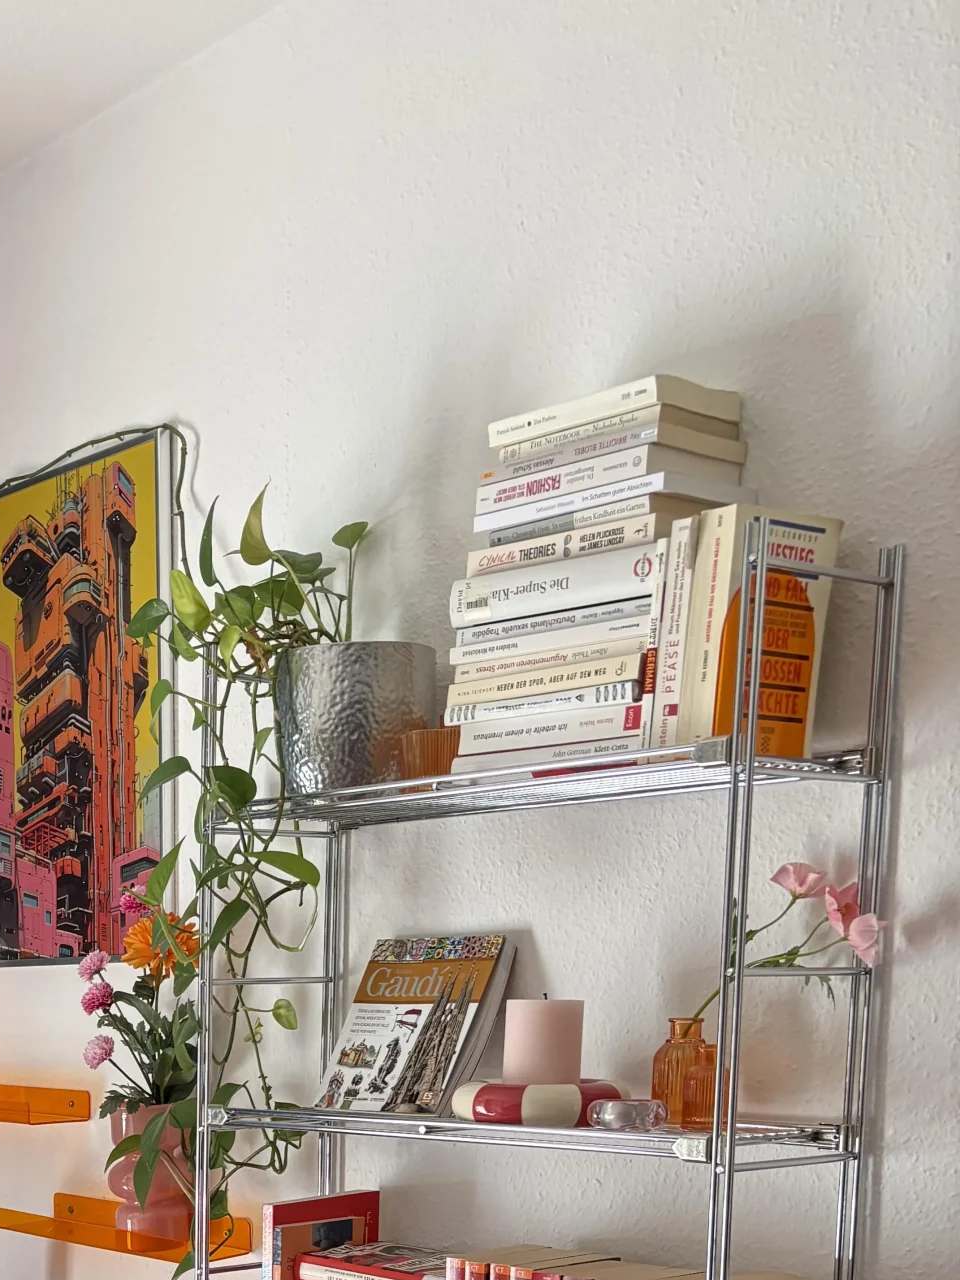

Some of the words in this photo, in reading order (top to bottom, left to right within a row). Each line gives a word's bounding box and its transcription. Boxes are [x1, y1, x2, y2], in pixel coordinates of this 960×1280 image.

[544, 431, 580, 446] NOTEBOOK
[598, 435, 627, 450] BRIGITTE
[574, 444, 597, 456] BLOBEL
[525, 473, 561, 497] FASHION
[589, 491, 611, 503] Schatten
[612, 487, 625, 498] guter
[626, 480, 653, 492] Absichten
[575, 514, 592, 525] frühen
[592, 508, 616, 520] Kindheit
[617, 506, 626, 514] ein
[626, 502, 646, 512] Garten
[579, 532, 595, 543] HELEN
[595, 526, 625, 541] PLUCKROSE
[587, 540, 603, 551] JAMES
[603, 535, 625, 549] LINDSAY
[478, 552, 516, 568] CYNICAL
[519, 543, 556, 562] THEORIES
[550, 577, 569, 590] Die
[501, 622, 529, 634] sexuelle
[530, 615, 576, 630] Deutschlands
[472, 626, 500, 639] Tragödie
[649, 617, 658, 646] DIRTY
[766, 626, 790, 650] DER
[496, 662, 515, 671] unter
[515, 653, 569, 668] Argumentieren
[664, 640, 680, 694] PEASE
[476, 664, 496, 674] Stress
[644, 650, 656, 691] GERMAN
[516, 680, 527, 689] DER
[548, 674, 564, 683] ABER
[566, 672, 578, 681] AUF
[579, 670, 592, 679] DEM
[593, 667, 607, 677] WEG
[626, 708, 635, 728] Econ
[505, 728, 525, 738] einem
[532, 725, 556, 735] arbeite
[557, 723, 568, 732] Ich
[473, 730, 504, 741] Irrenhaus
[593, 742, 629, 754] Klett-Cotta
[366, 965, 450, 998] Gaudí
